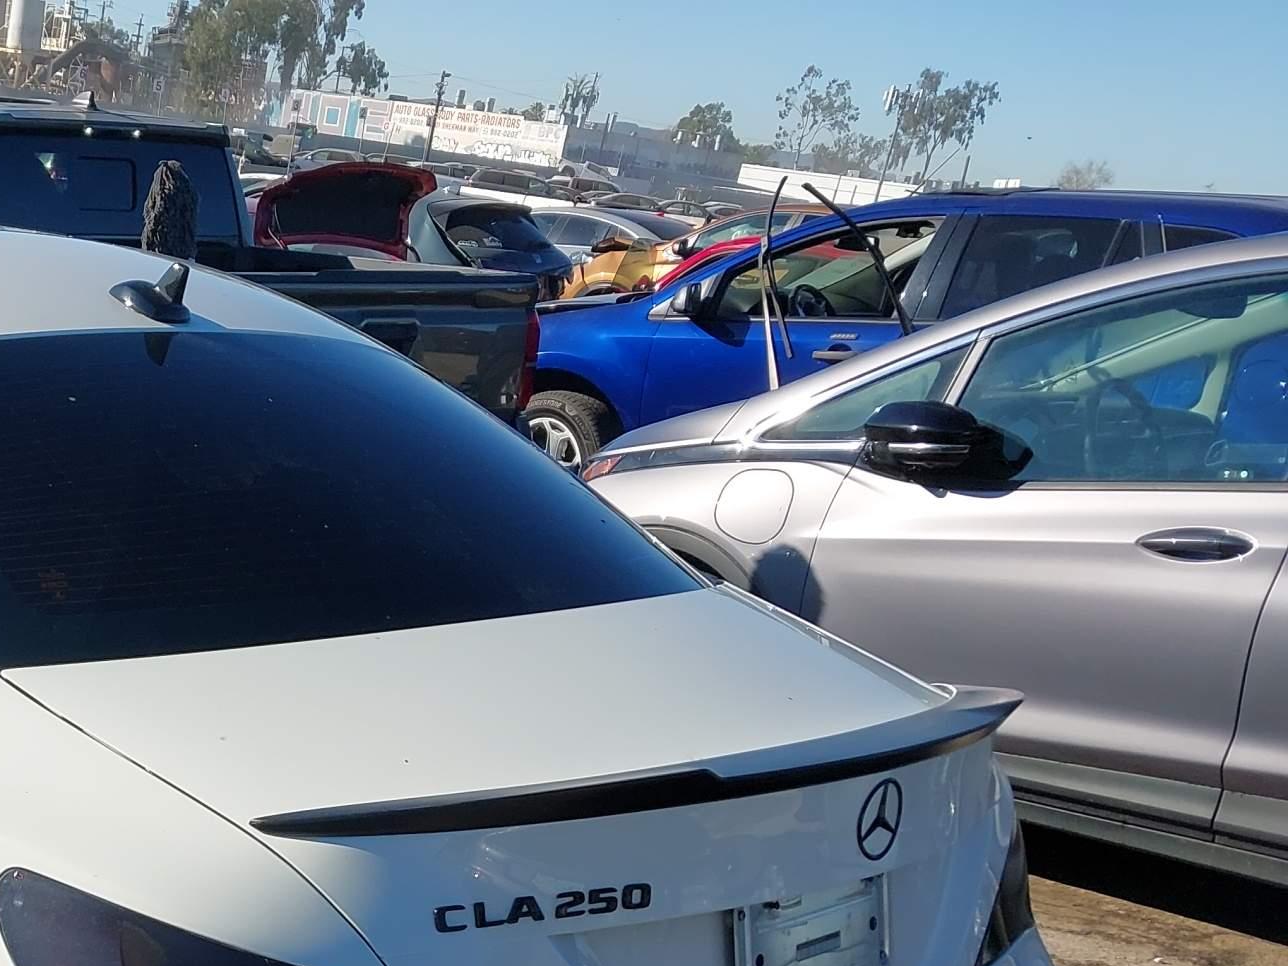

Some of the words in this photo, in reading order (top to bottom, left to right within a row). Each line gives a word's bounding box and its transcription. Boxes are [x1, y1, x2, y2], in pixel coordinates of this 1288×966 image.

[155, 81, 162, 91] 5
[394, 104, 412, 115] AUTO
[413, 106, 435, 118] GLASS
[433, 895, 545, 933] CLA
[555, 883, 652, 919] 250
